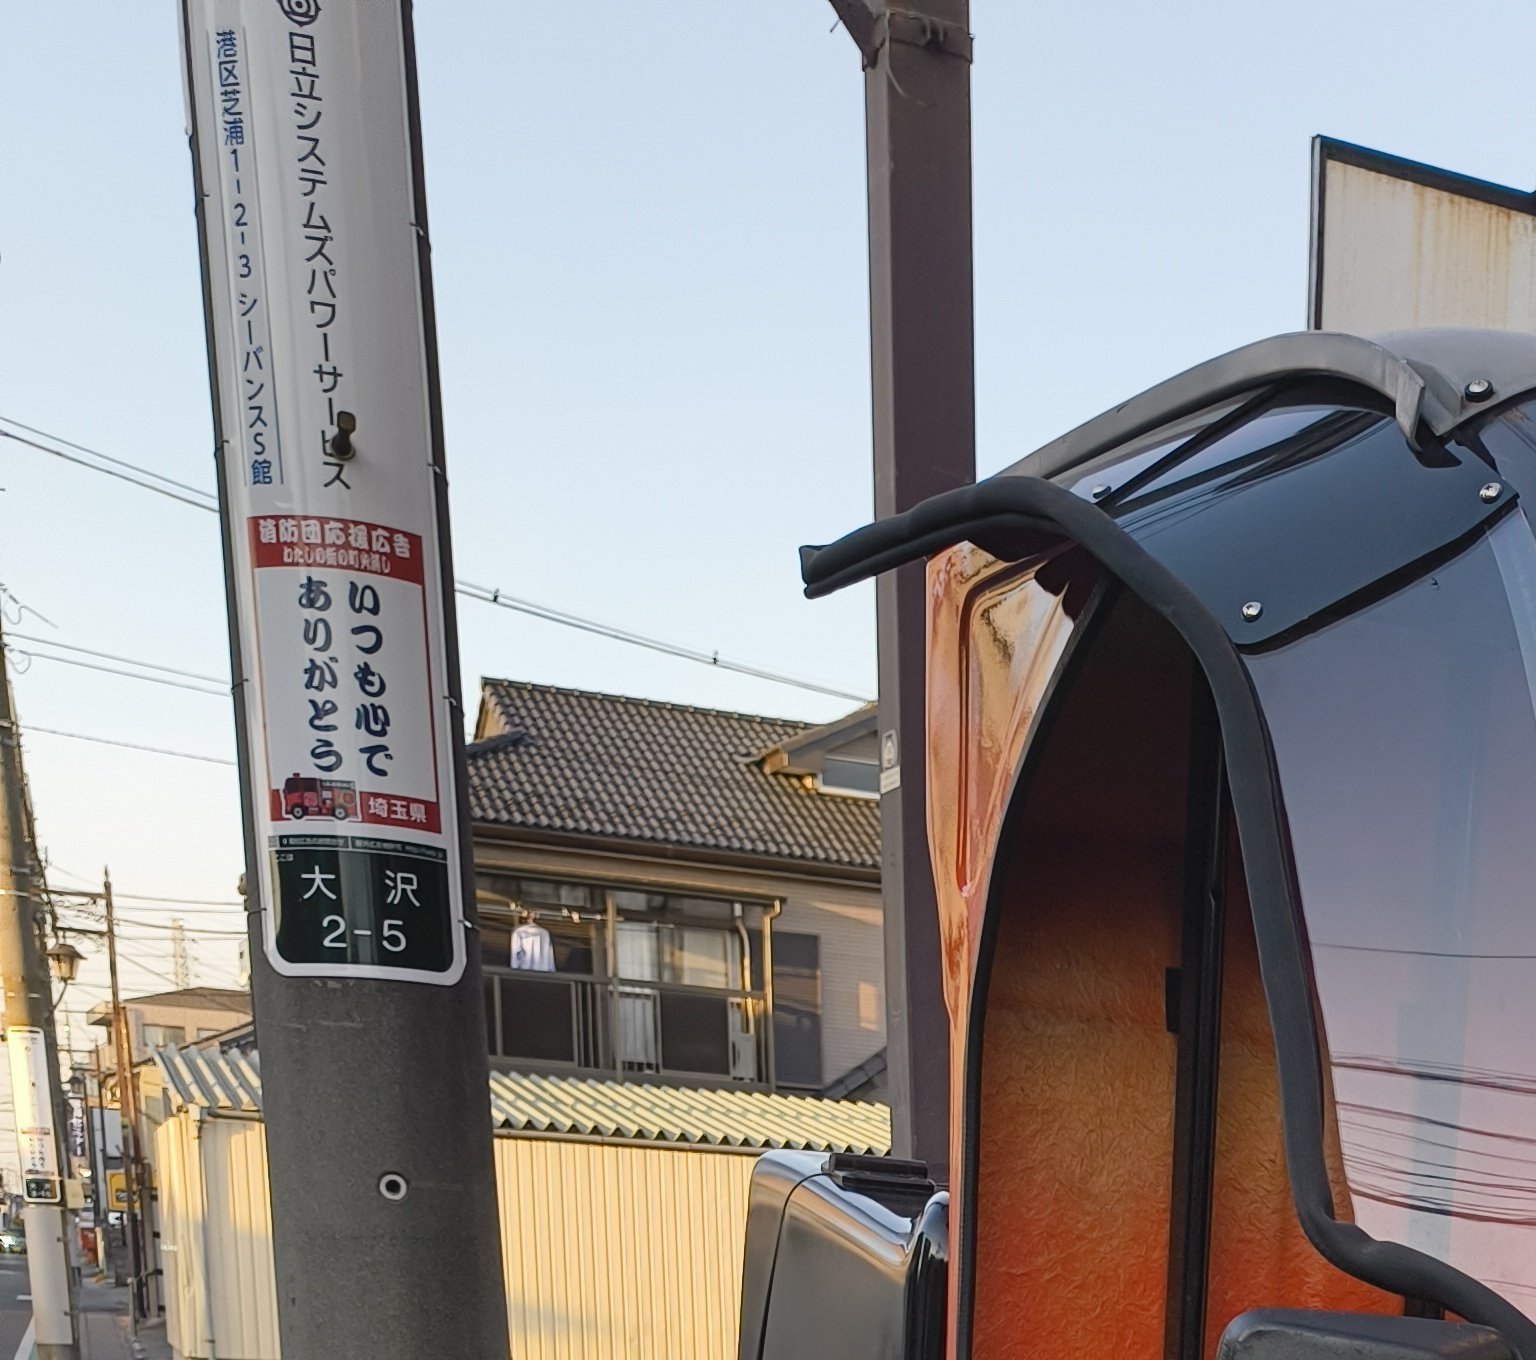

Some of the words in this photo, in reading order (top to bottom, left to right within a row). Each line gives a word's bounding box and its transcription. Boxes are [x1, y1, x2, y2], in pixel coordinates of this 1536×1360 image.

[258, 518, 411, 558] 消防団応援広告
[298, 575, 343, 772] ありがとう
[348, 581, 394, 777] いつも心で
[367, 796, 428, 823] 埼玉県
[322, 915, 407, 952] 2-5
